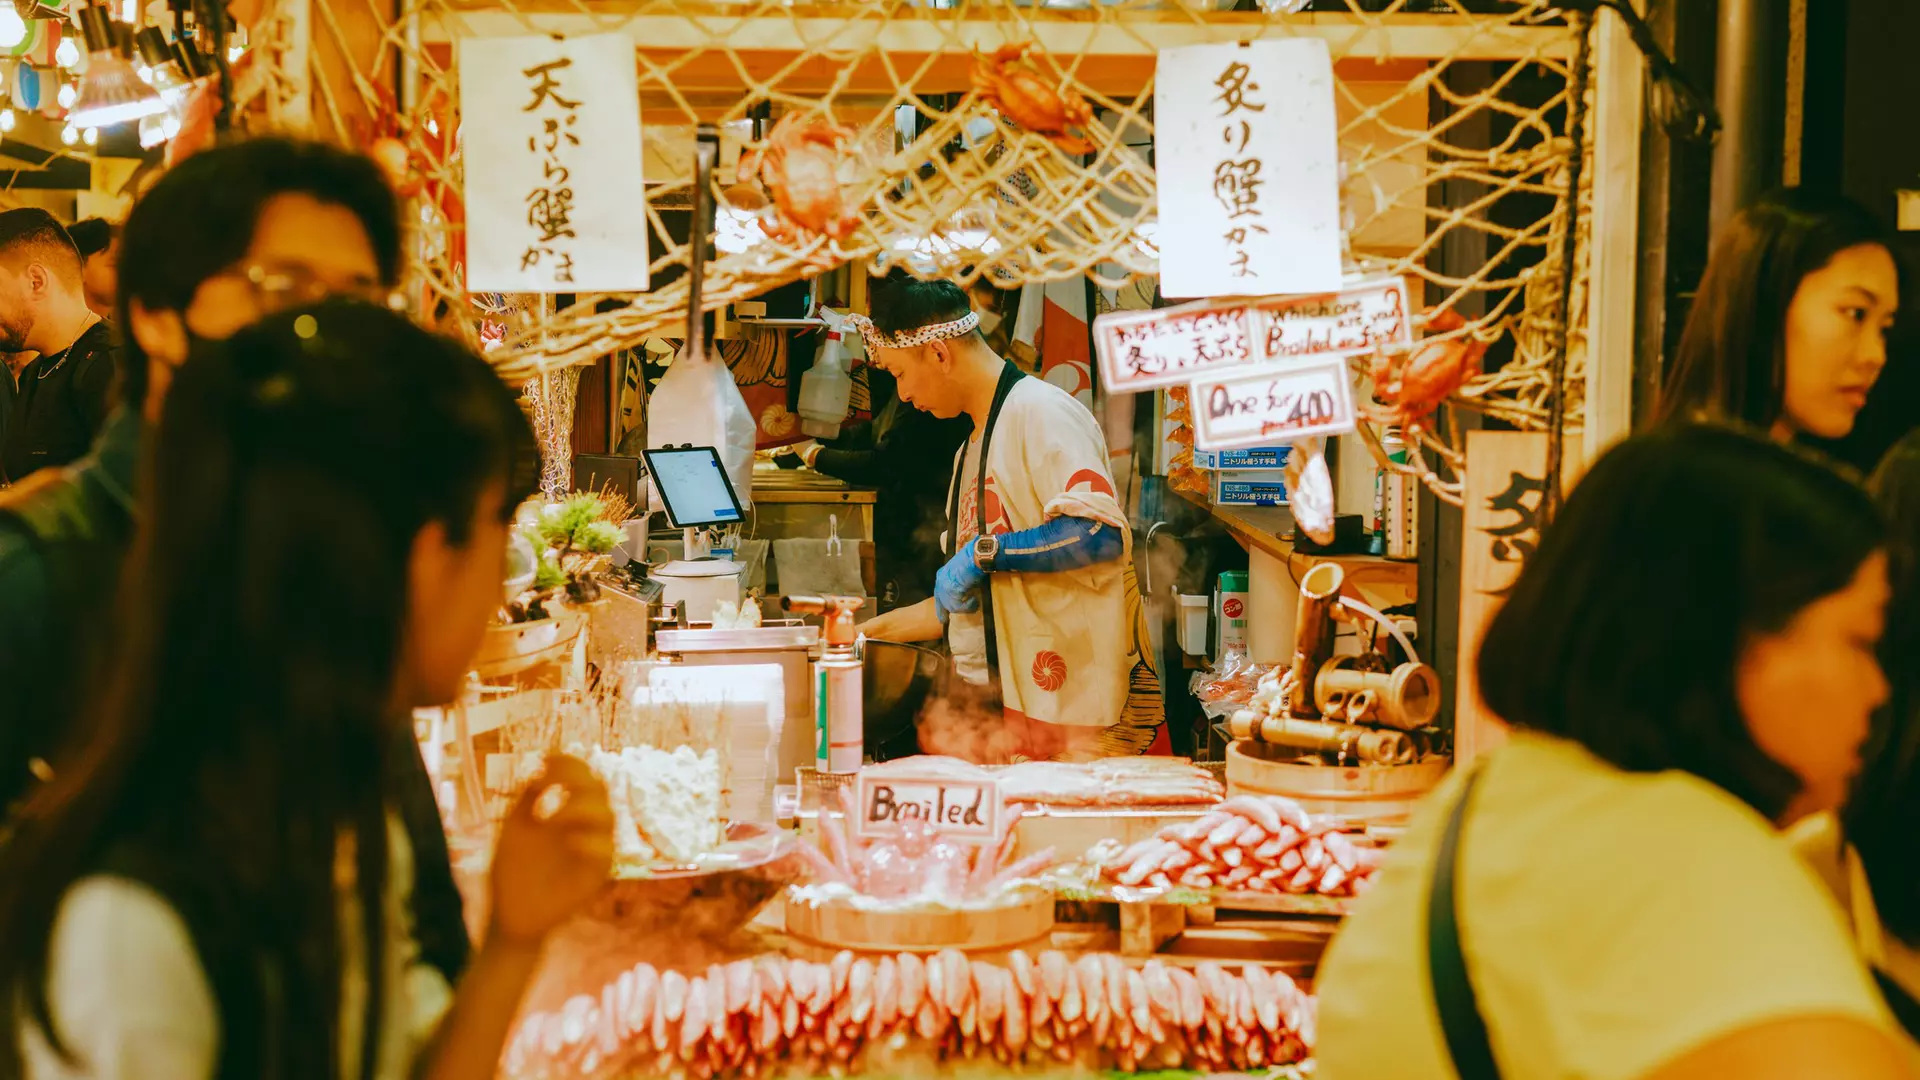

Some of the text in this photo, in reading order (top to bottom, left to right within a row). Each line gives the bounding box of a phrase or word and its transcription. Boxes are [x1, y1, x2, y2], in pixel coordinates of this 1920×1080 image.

[1209, 380, 1334, 428] One for 400
